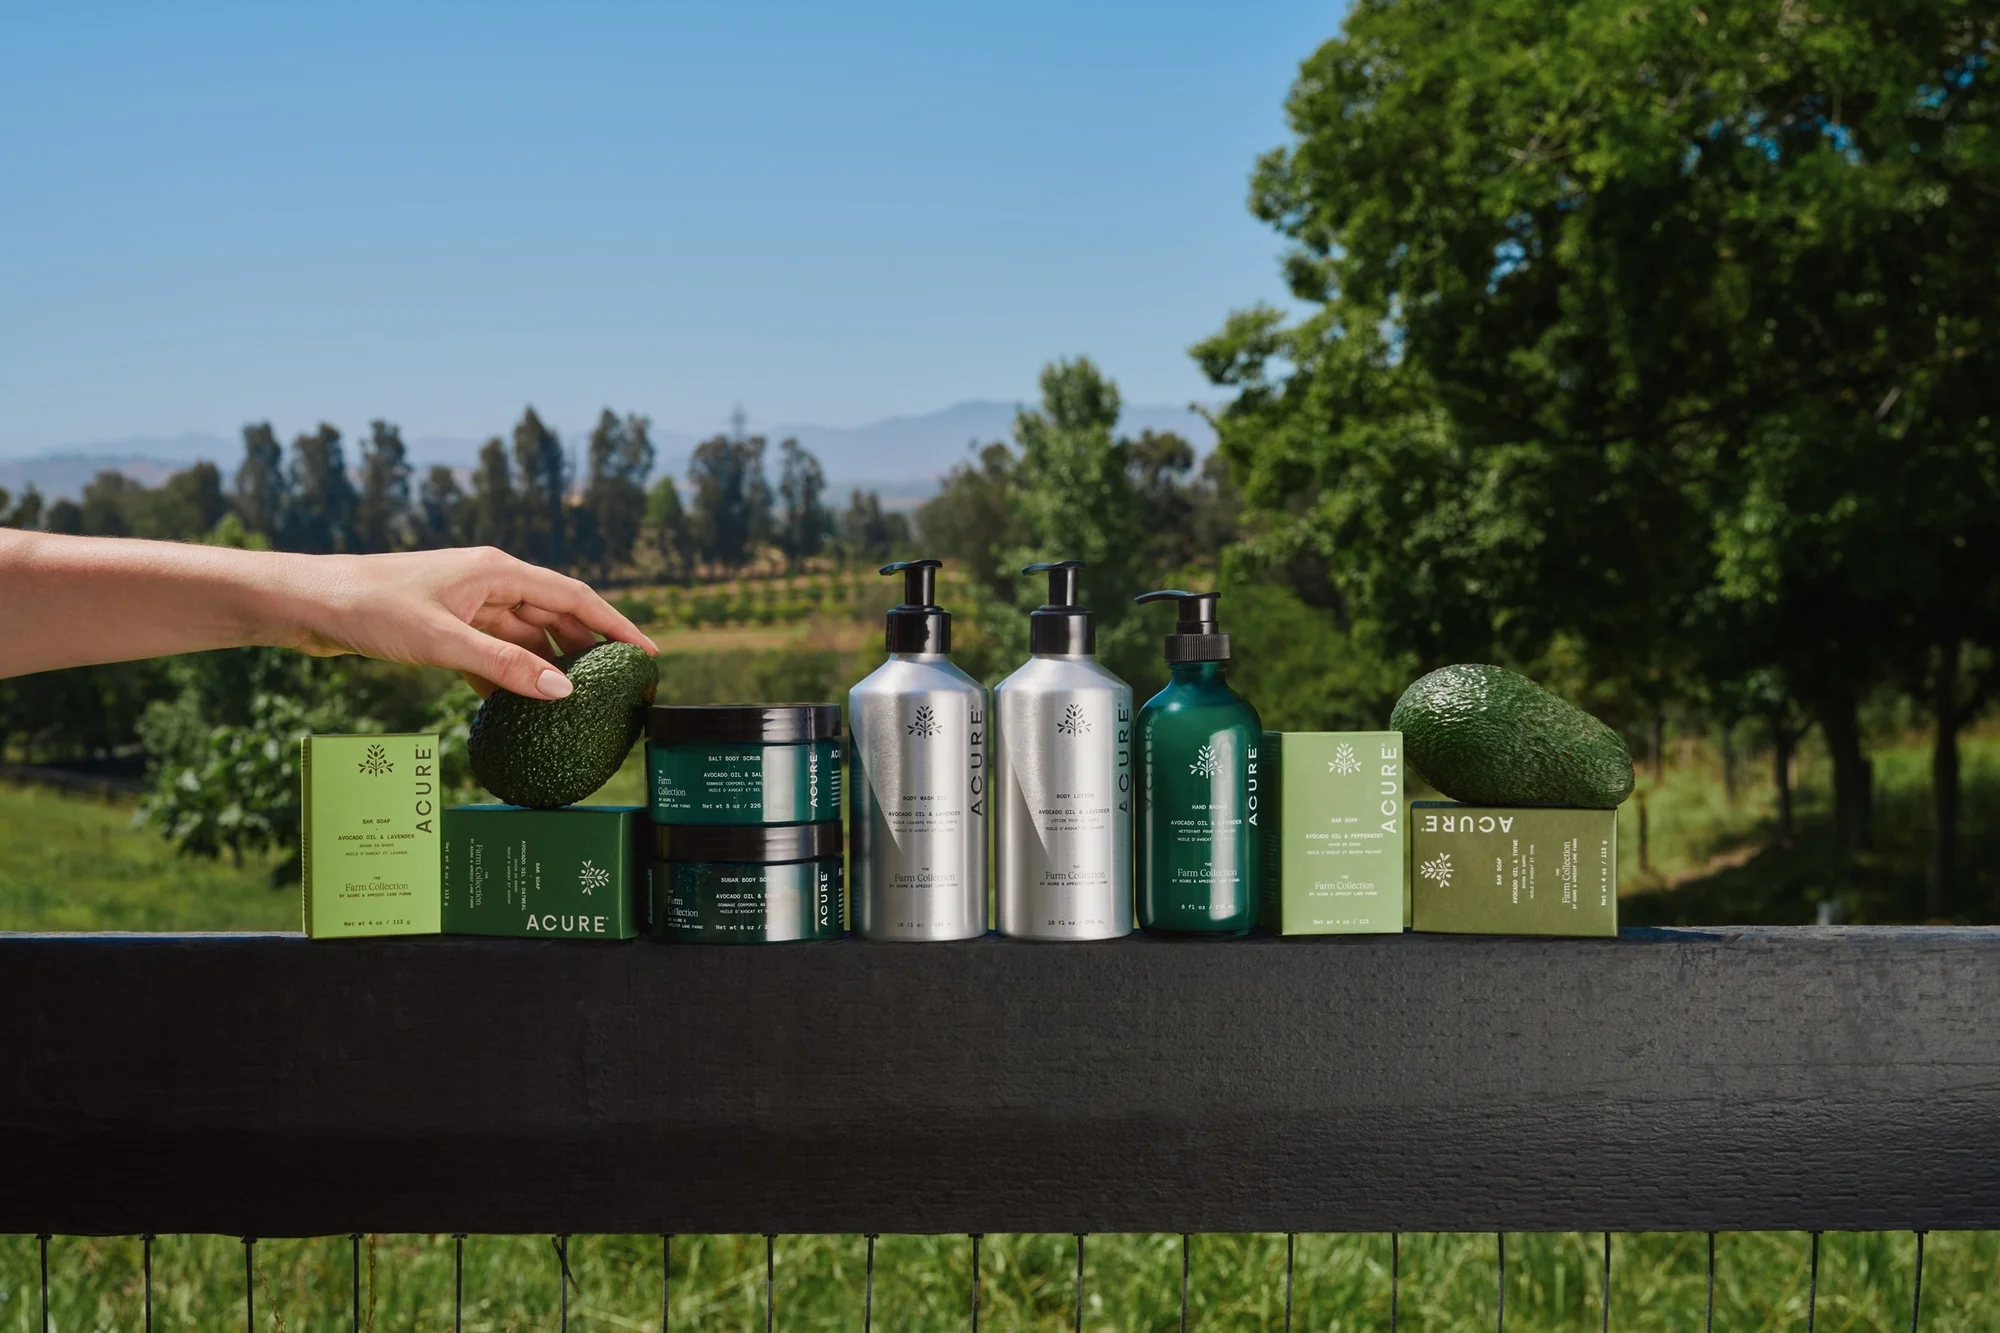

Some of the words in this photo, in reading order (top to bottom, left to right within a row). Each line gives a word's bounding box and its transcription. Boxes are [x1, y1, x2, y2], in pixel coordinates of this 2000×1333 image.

[970, 709, 983, 816] ACURE
[1118, 708, 1129, 813] ACURE
[658, 776, 672, 785] Farm
[809, 754, 818, 807] ACURE
[1248, 747, 1258, 826] ACURE
[415, 748, 432, 834] ACURE
[658, 787, 686, 796] Collection
[1381, 747, 1397, 833] ACURE
[1425, 815, 1514, 833] ACURE
[1562, 841, 1570, 881] Collection
[894, 874, 915, 882] Farm
[917, 873, 955, 882] Collection
[1045, 871, 1066, 880] Farm
[1068, 871, 1105, 879] Collection
[1177, 869, 1198, 877] Farm
[1199, 868, 1237, 877] Collection
[345, 883, 367, 892] Farm
[368, 882, 409, 891] Collection
[475, 866, 483, 906] Collection
[1315, 882, 1335, 890] Farm
[1336, 881, 1374, 890] Collection
[1562, 883, 1570, 904] Farm
[668, 896, 683, 906] Farm
[668, 907, 699, 917] Collection
[526, 914, 605, 933] ACURE
